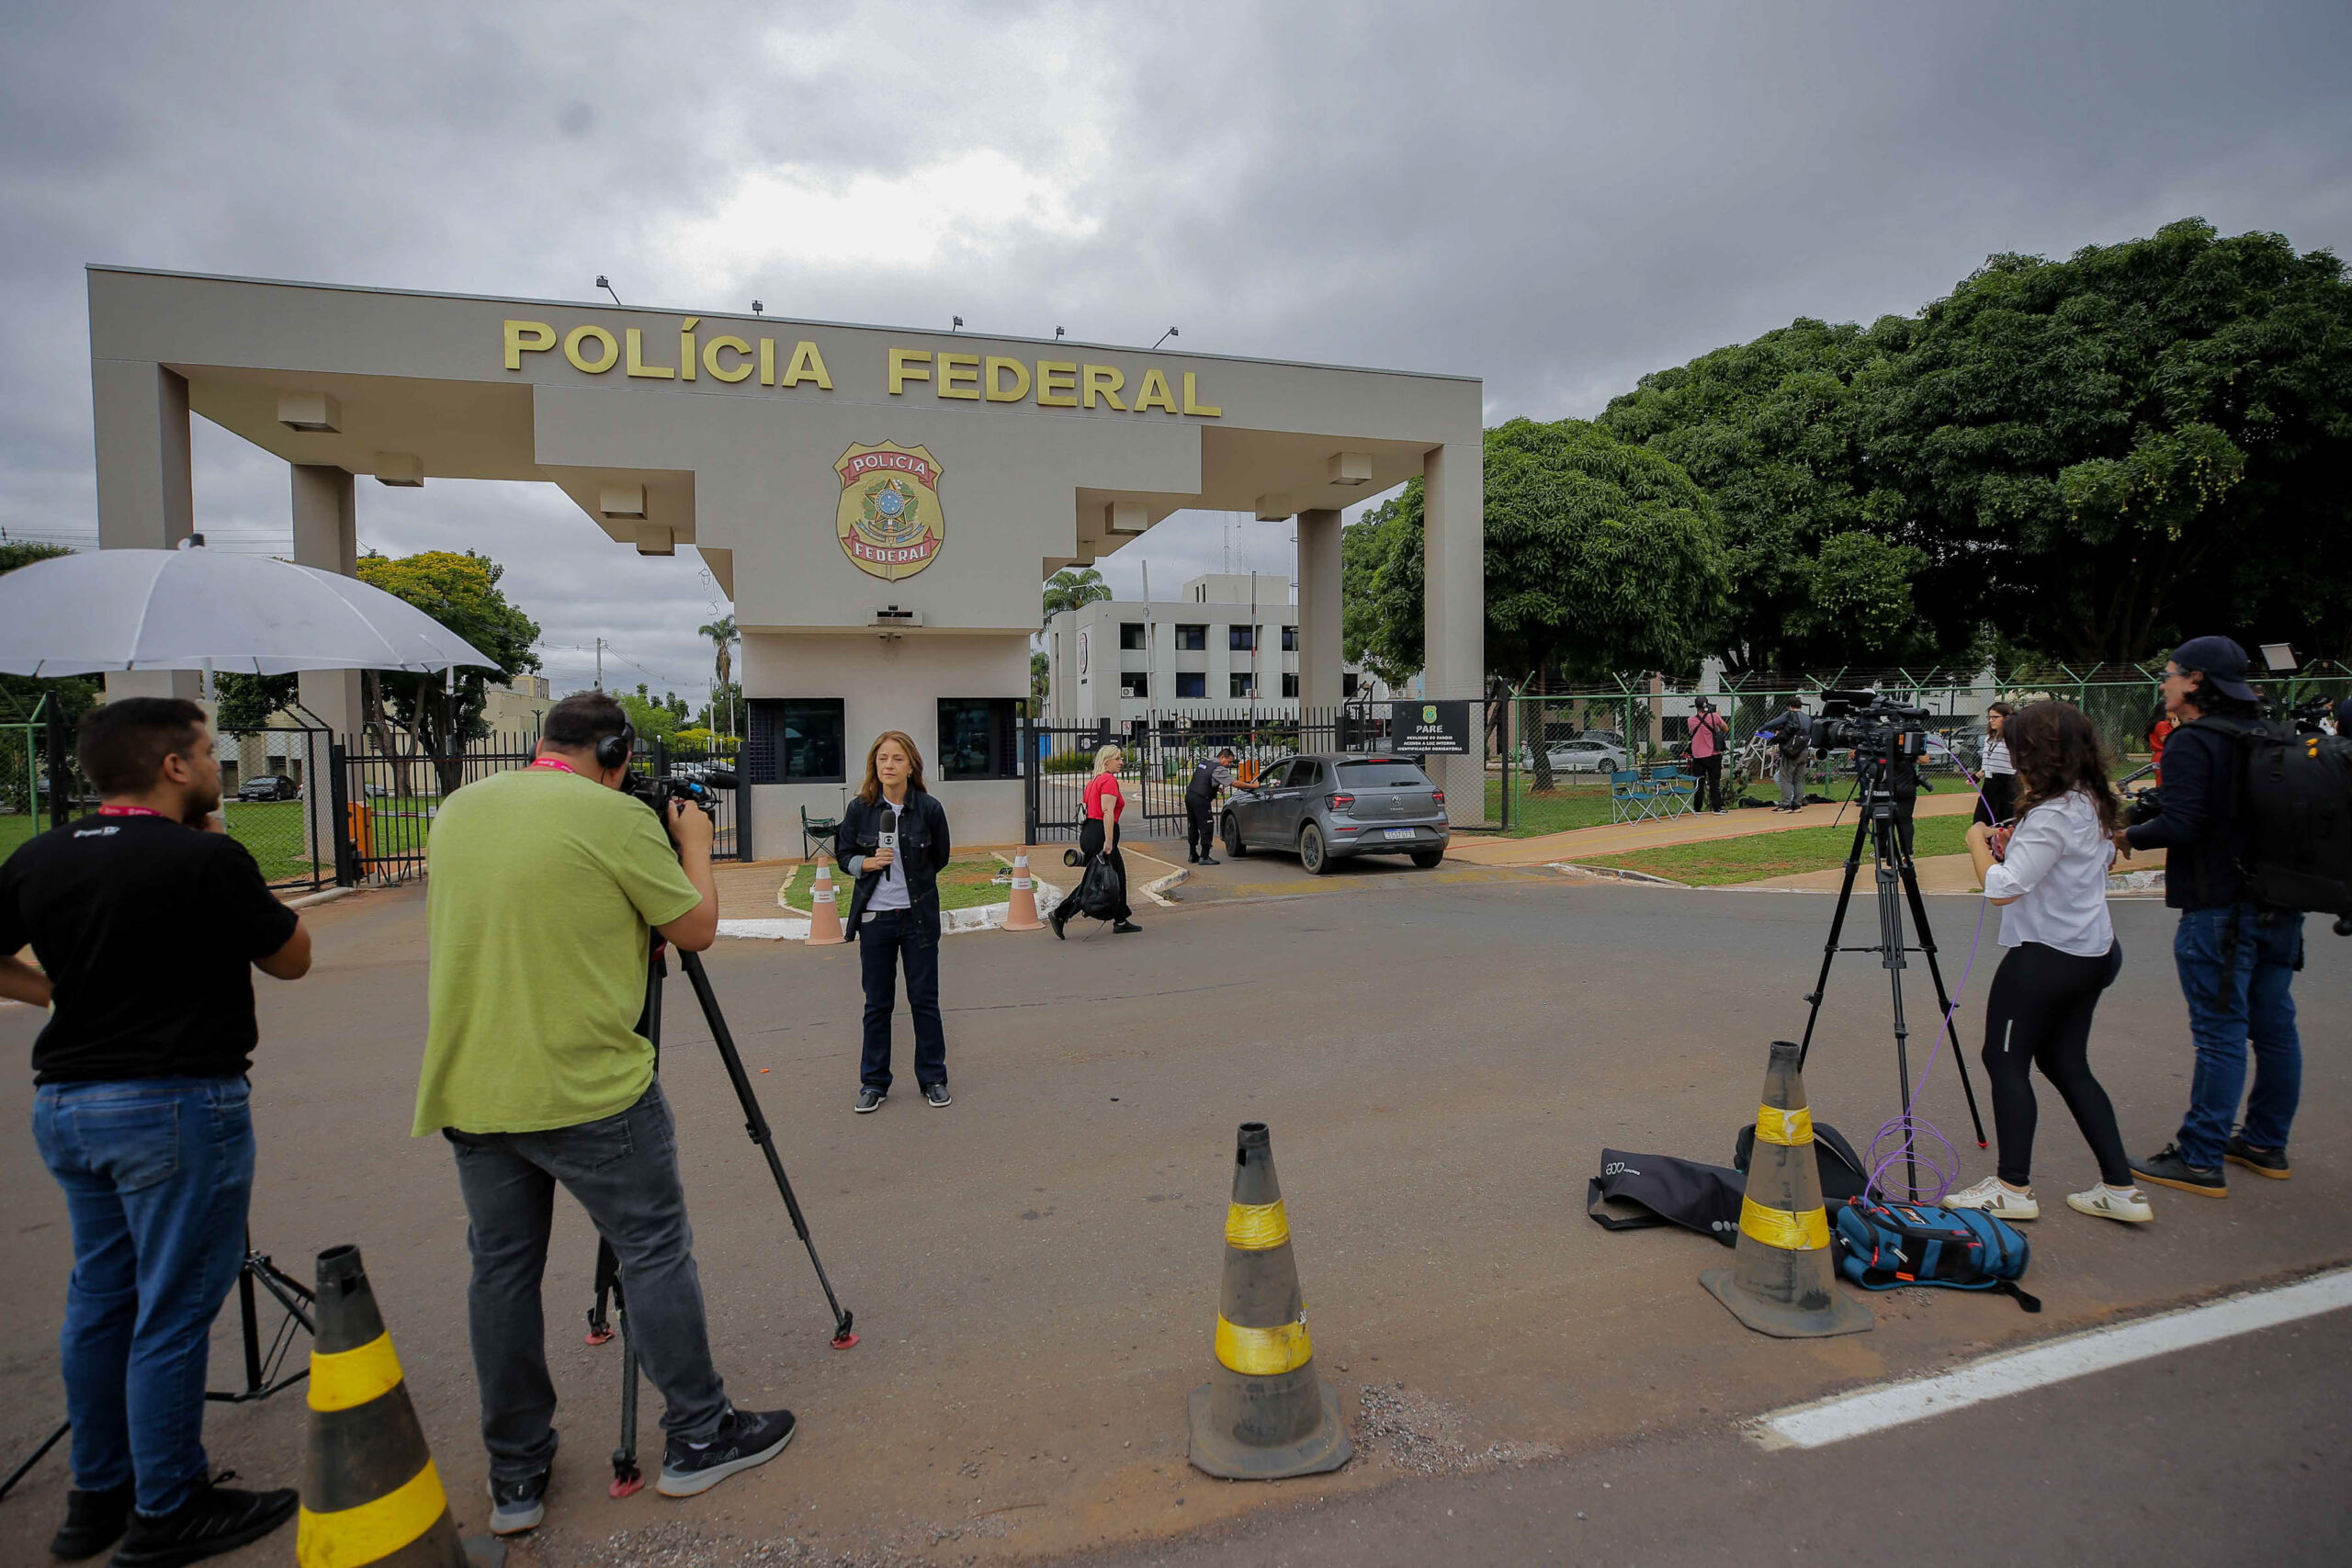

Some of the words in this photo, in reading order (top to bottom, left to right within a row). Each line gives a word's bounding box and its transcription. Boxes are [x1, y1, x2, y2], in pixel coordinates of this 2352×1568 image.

[503, 317, 832, 391] POLÍCIA
[888, 347, 1223, 417] FEDERAL
[853, 455, 926, 476] POLÍCIA
[854, 542, 928, 562] FEDERAL
[1416, 725, 1443, 733] PARE
